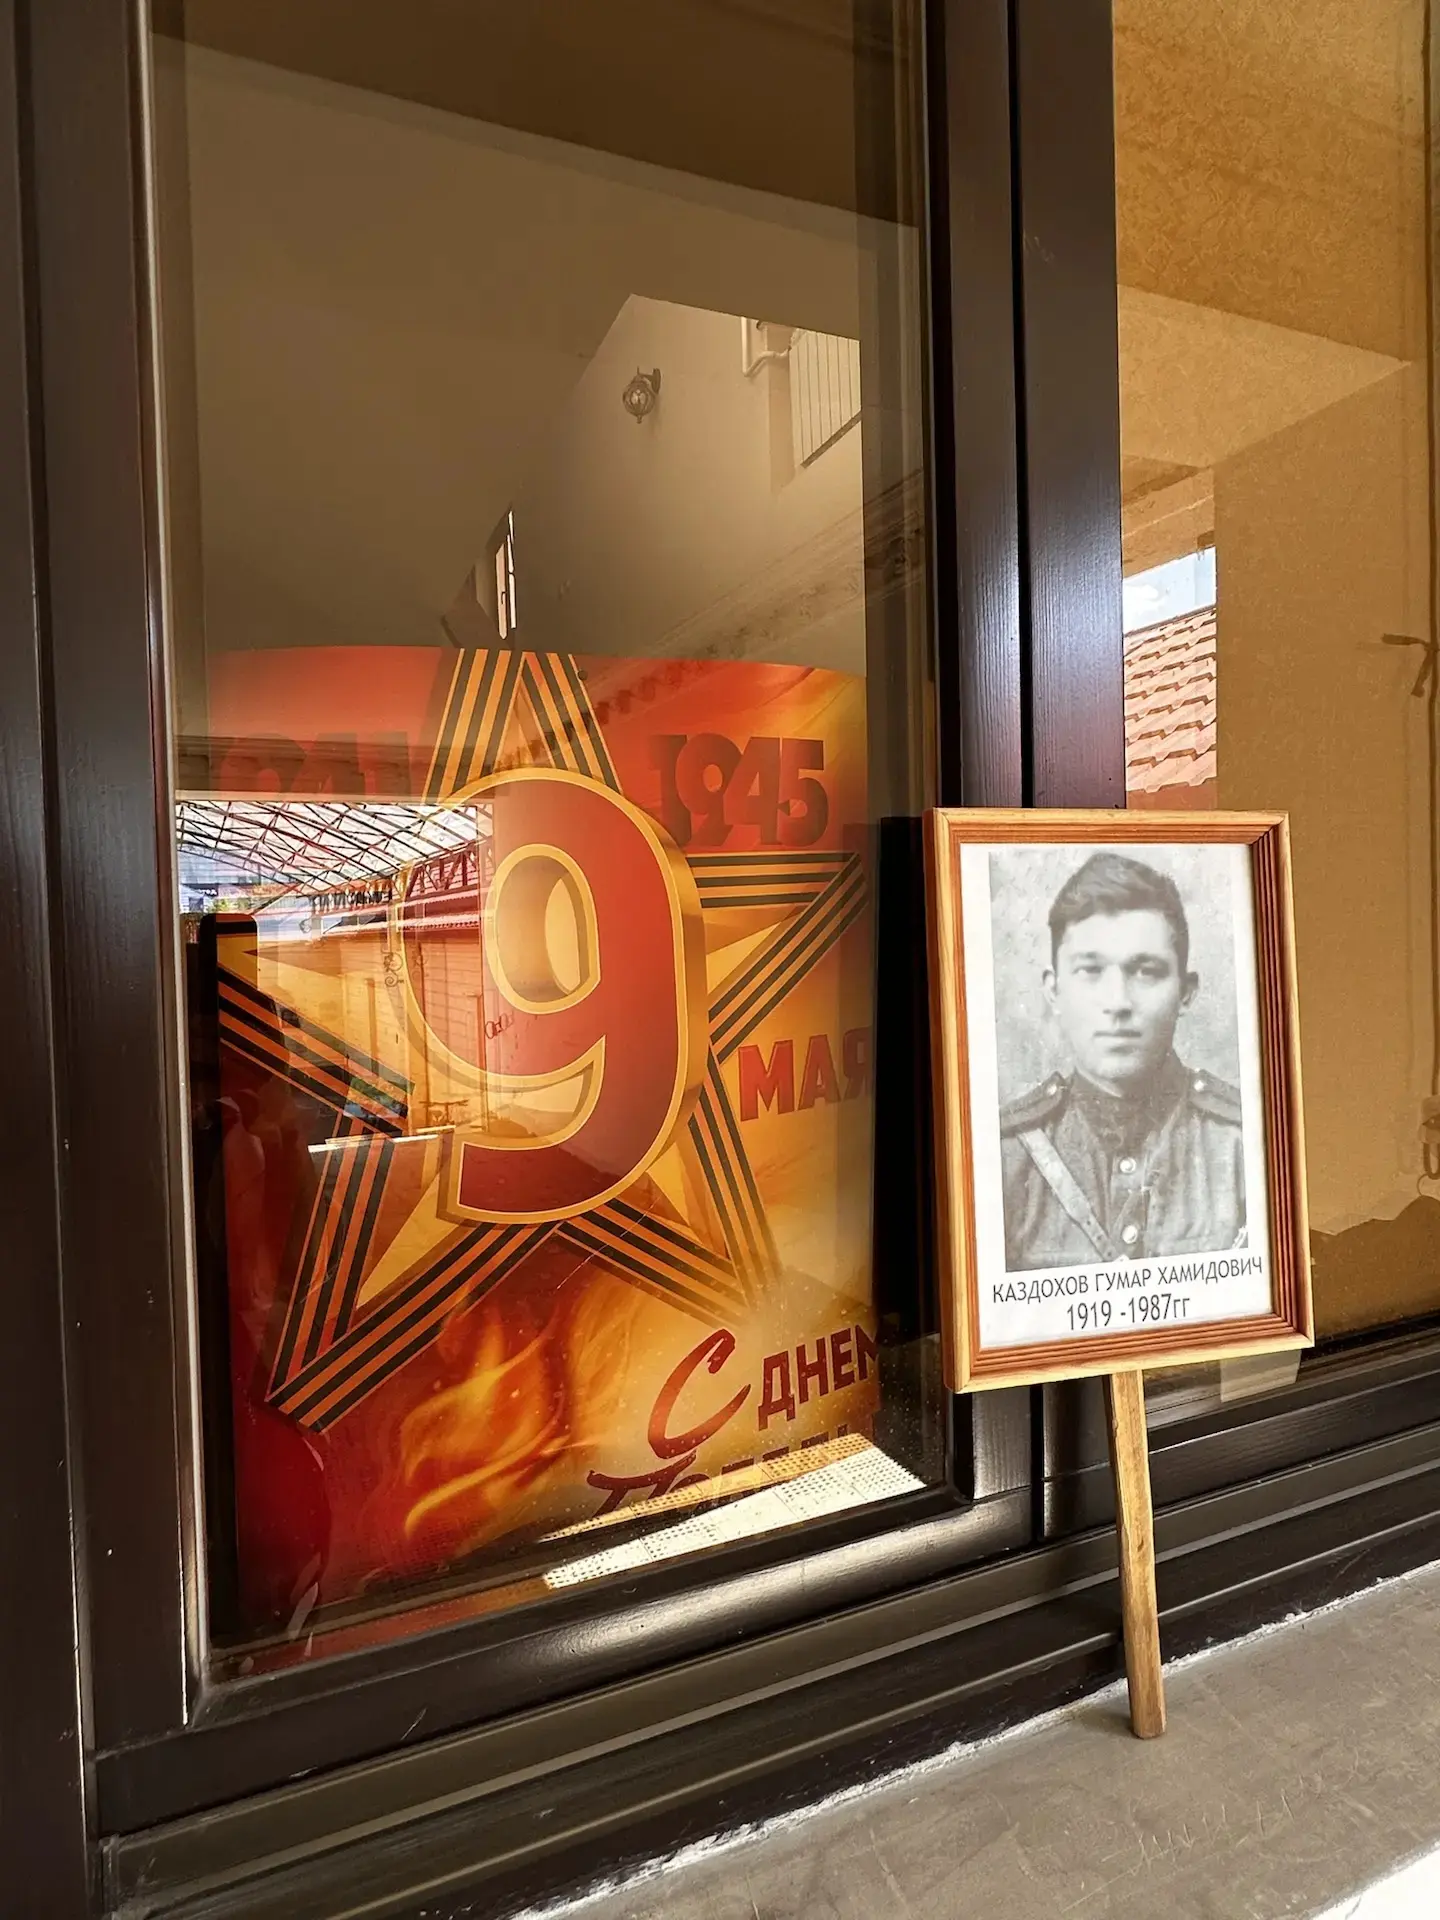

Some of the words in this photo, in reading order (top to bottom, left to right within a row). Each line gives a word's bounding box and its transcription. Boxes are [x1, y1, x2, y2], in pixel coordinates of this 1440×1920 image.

[648, 732, 830, 848] 1945
[396, 767, 707, 1225] 9
[738, 1025, 872, 1122] МАЯ
[992, 1274, 1089, 1305] КАЗДОХОВ
[1095, 1267, 1152, 1292] ГУМАР
[1158, 1255, 1263, 1285] ХАМИДОВИЧ
[1066, 1299, 1112, 1331] 1919
[647, 1327, 752, 1460] С
